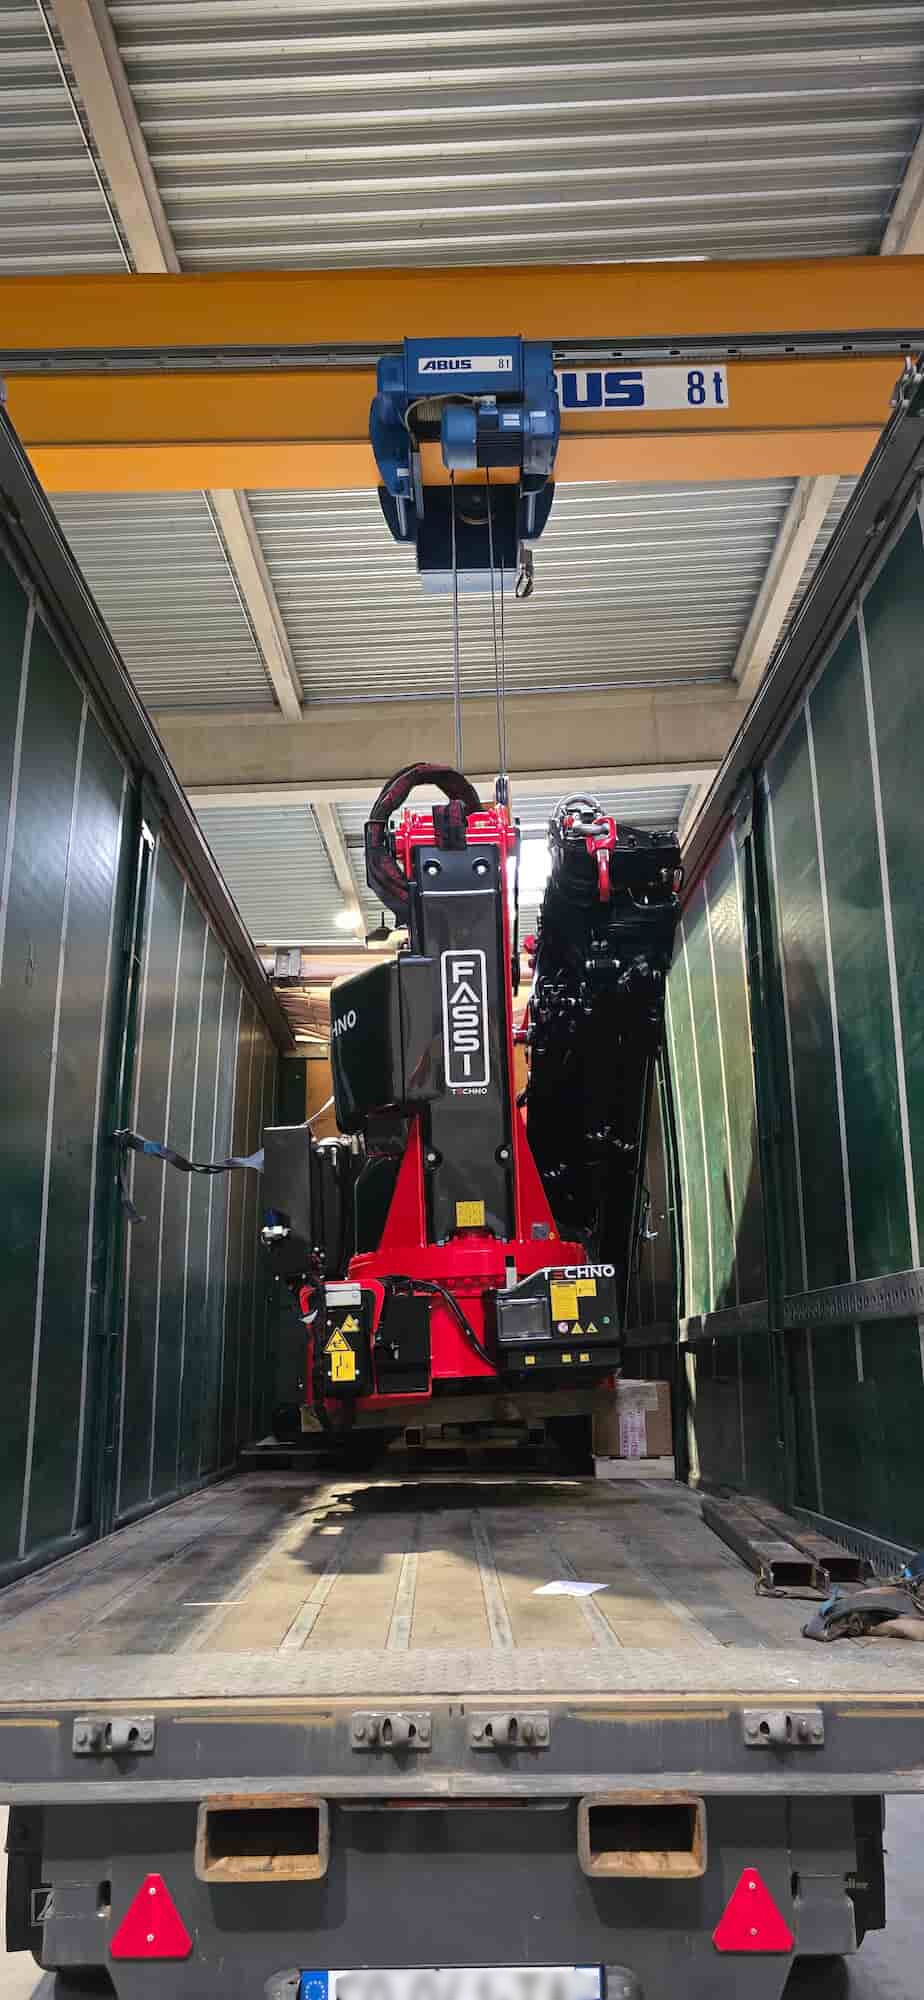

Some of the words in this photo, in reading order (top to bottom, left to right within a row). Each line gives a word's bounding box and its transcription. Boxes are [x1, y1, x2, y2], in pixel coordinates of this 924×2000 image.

[423, 359, 472, 370] ABUS
[555, 371, 645, 408] US
[449, 961, 480, 1076] FASSI
[450, 1087, 488, 1096] TECHNO
[542, 1265, 616, 1281] TECHNO
